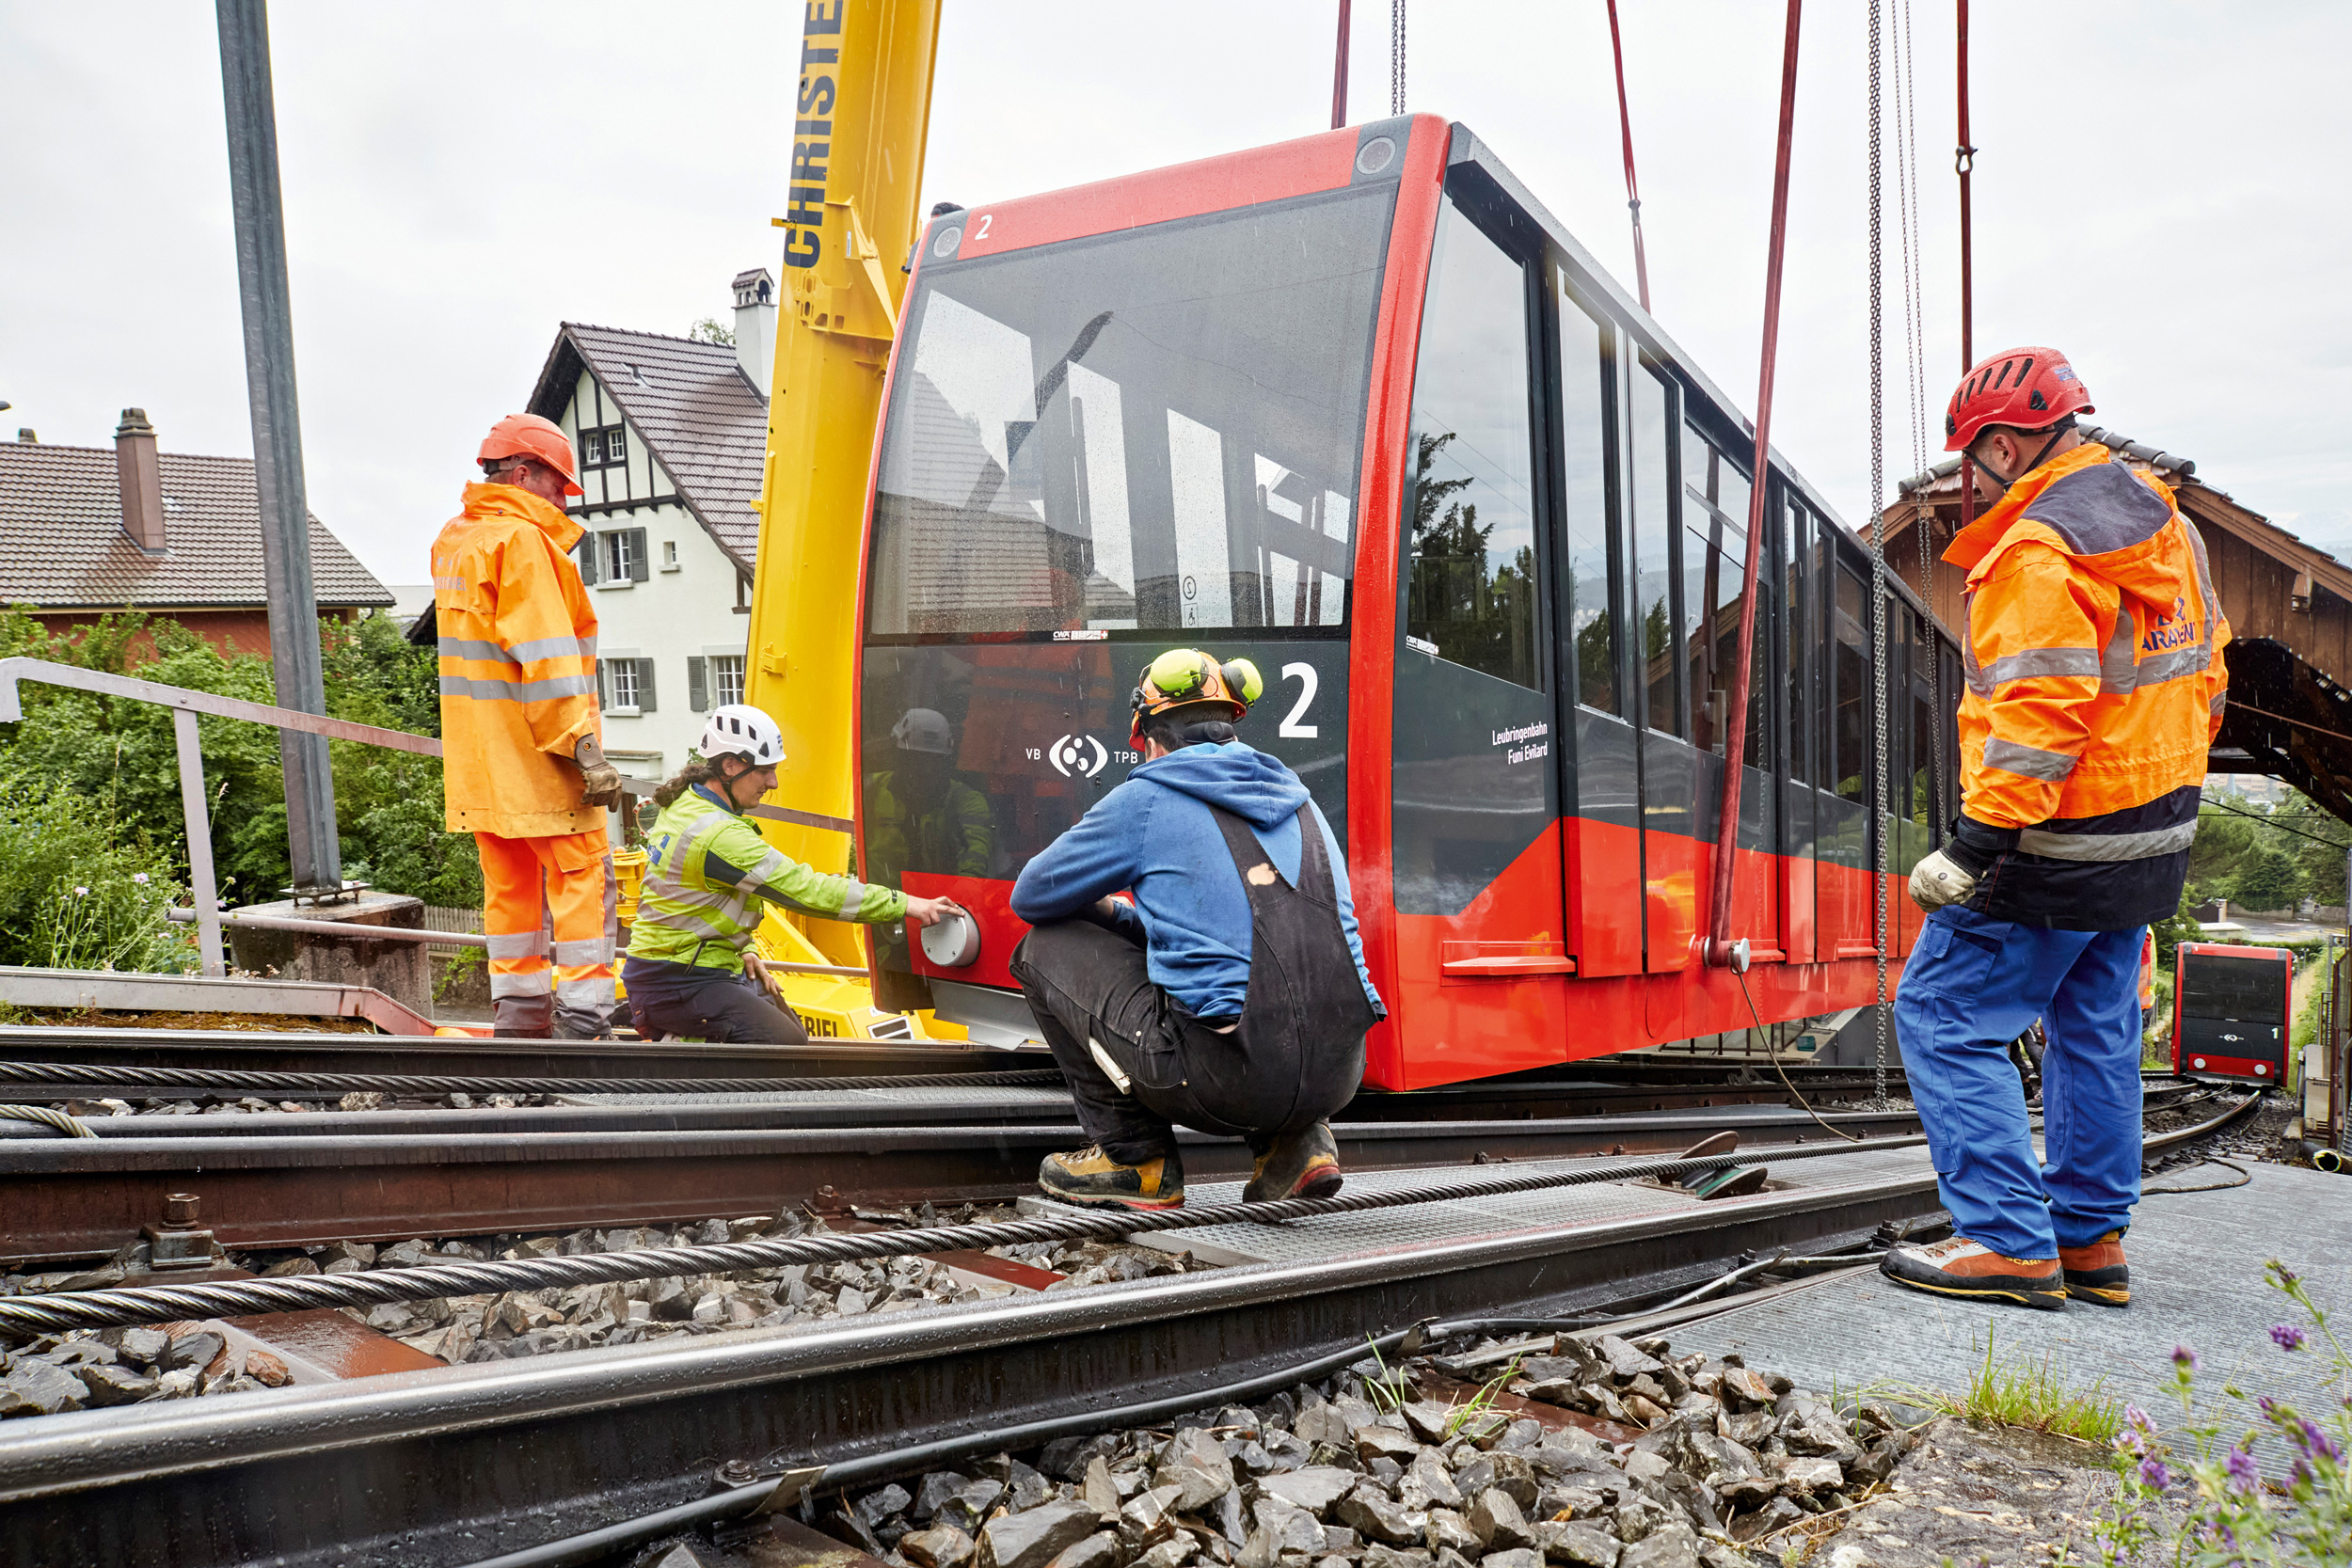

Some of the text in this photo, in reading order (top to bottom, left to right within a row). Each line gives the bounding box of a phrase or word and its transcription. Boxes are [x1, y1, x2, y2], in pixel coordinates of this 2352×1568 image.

[975, 214, 993, 241] 2
[1279, 662, 1318, 738] 2
[1492, 721, 1548, 745] Leubringenbahn
[1025, 748, 1138, 764] VB TPB
[1507, 740, 1549, 766] Funi Evilard
[2271, 1028, 2278, 1038] 1
